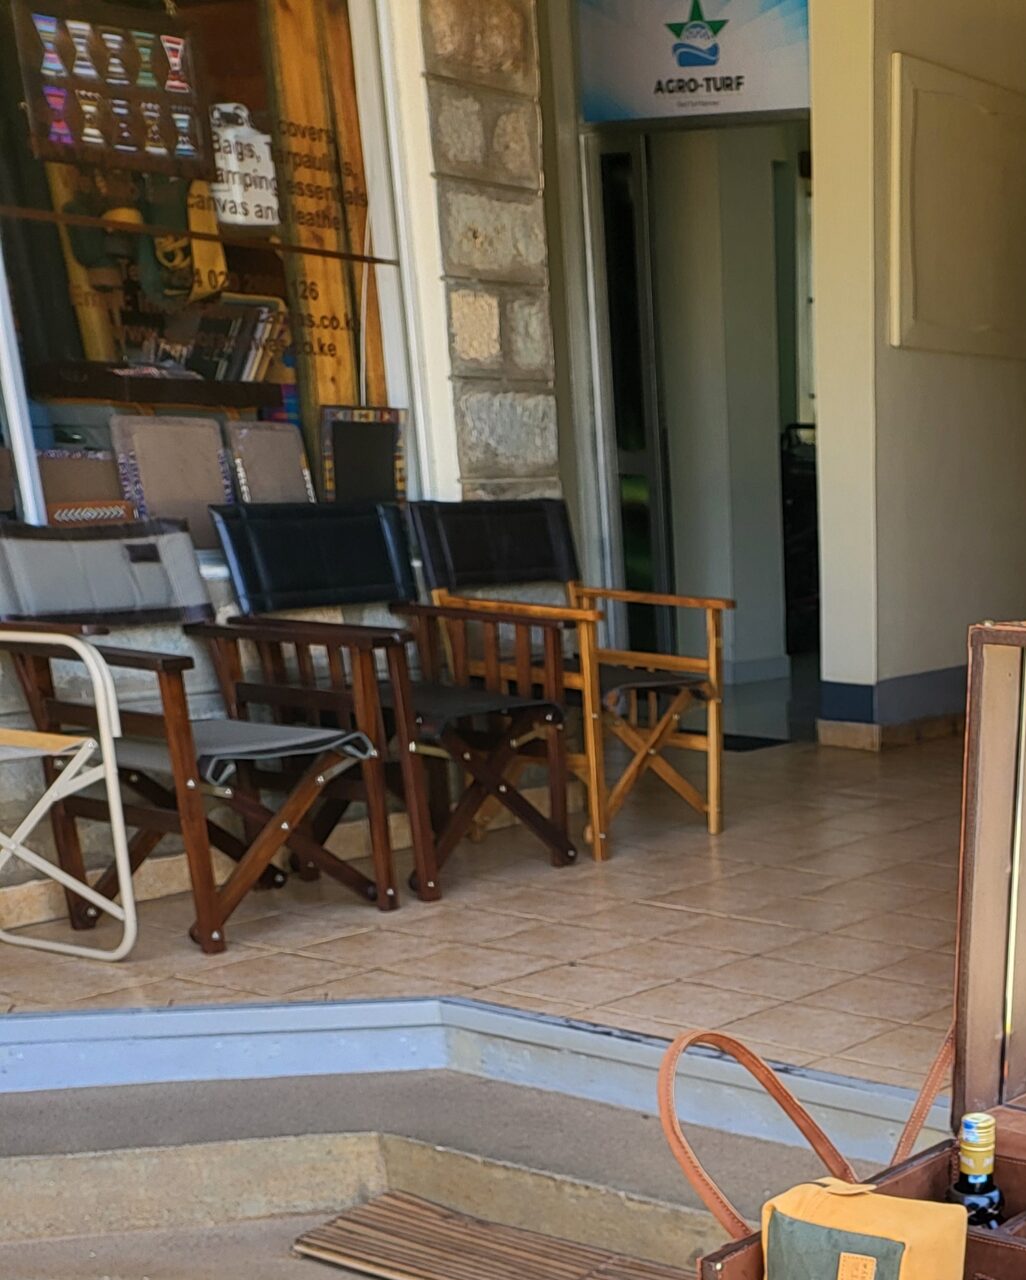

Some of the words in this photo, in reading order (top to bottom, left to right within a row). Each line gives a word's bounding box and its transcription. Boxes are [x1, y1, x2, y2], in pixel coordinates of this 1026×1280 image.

[653, 75, 745, 95] AGRO-TURF
[214, 166, 279, 197] amping
[253, 203, 283, 223] an
